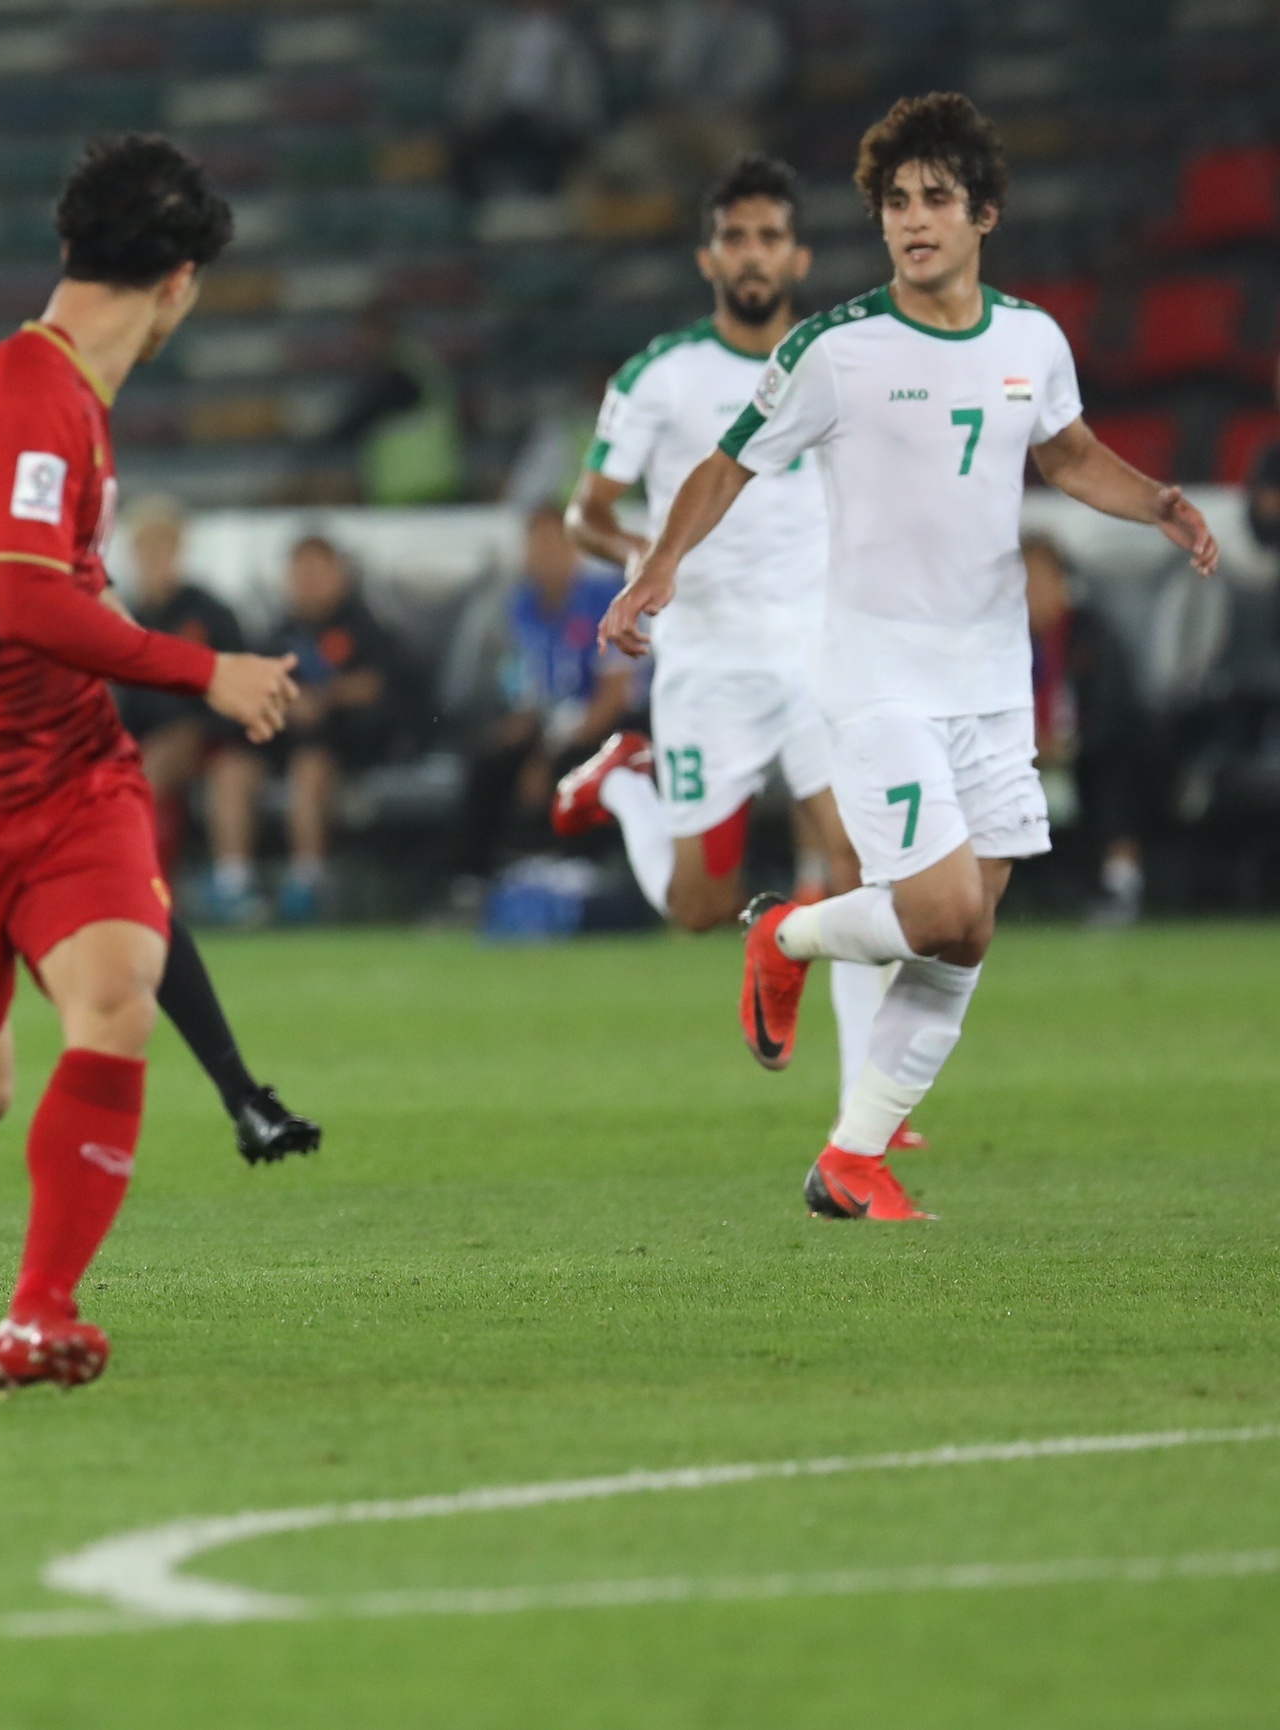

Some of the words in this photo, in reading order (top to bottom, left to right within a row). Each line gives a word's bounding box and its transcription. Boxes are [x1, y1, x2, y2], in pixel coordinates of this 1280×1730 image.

[888, 388, 928, 402] JAKO
[951, 408, 983, 475] 7
[667, 746, 704, 801] 13
[886, 781, 922, 849] 7
